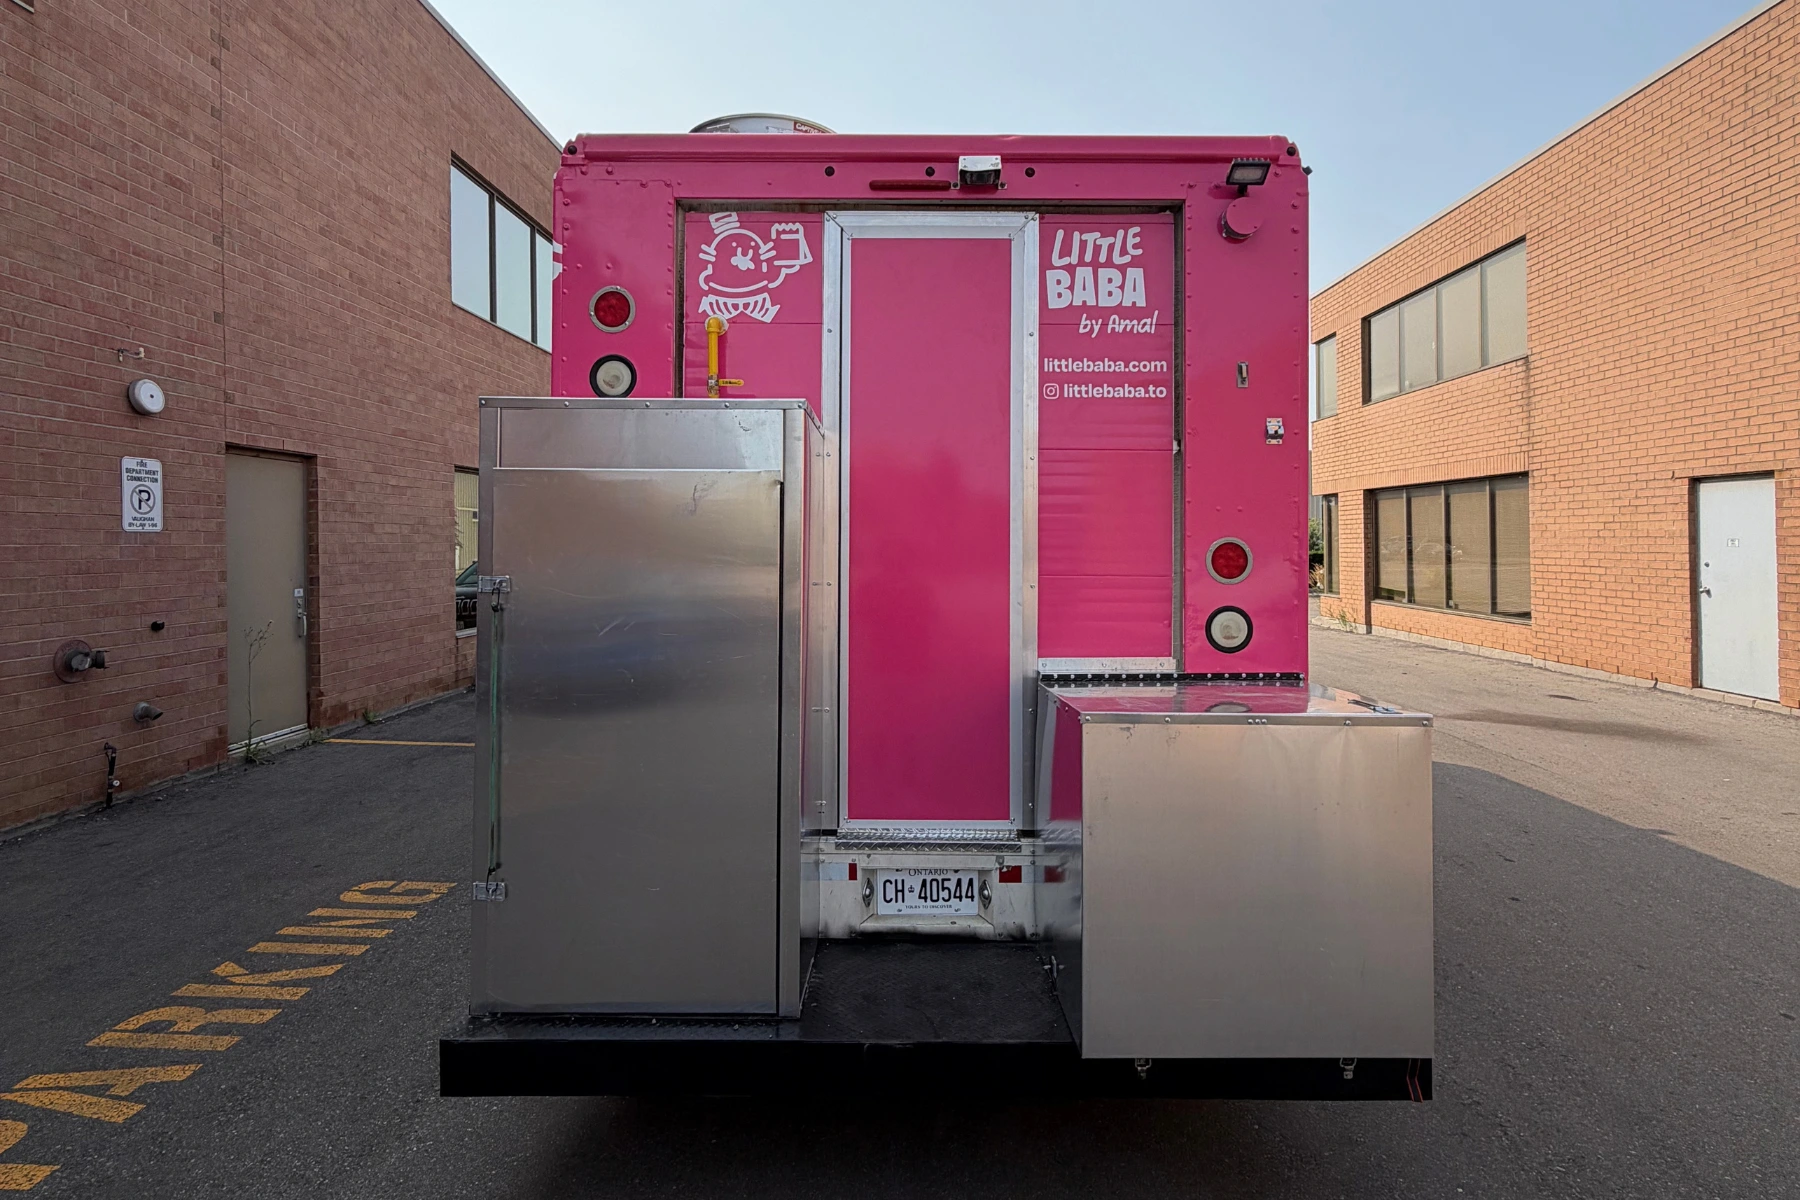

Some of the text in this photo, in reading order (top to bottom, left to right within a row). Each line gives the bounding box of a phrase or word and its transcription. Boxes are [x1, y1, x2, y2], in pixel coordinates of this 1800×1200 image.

[1051, 226, 1143, 267] LITTLE
[1045, 266, 1147, 309] BABA
[1078, 310, 1159, 338] by Amal
[1043, 357, 1168, 373] littlebaba.com
[1063, 383, 1168, 399] littlebaba.to
[125, 467, 159, 476] DEPARTMENT
[126, 475, 159, 483] CONNECTION
[908, 868, 949, 877] ONTARIO
[882, 877, 976, 904] CH 40544
